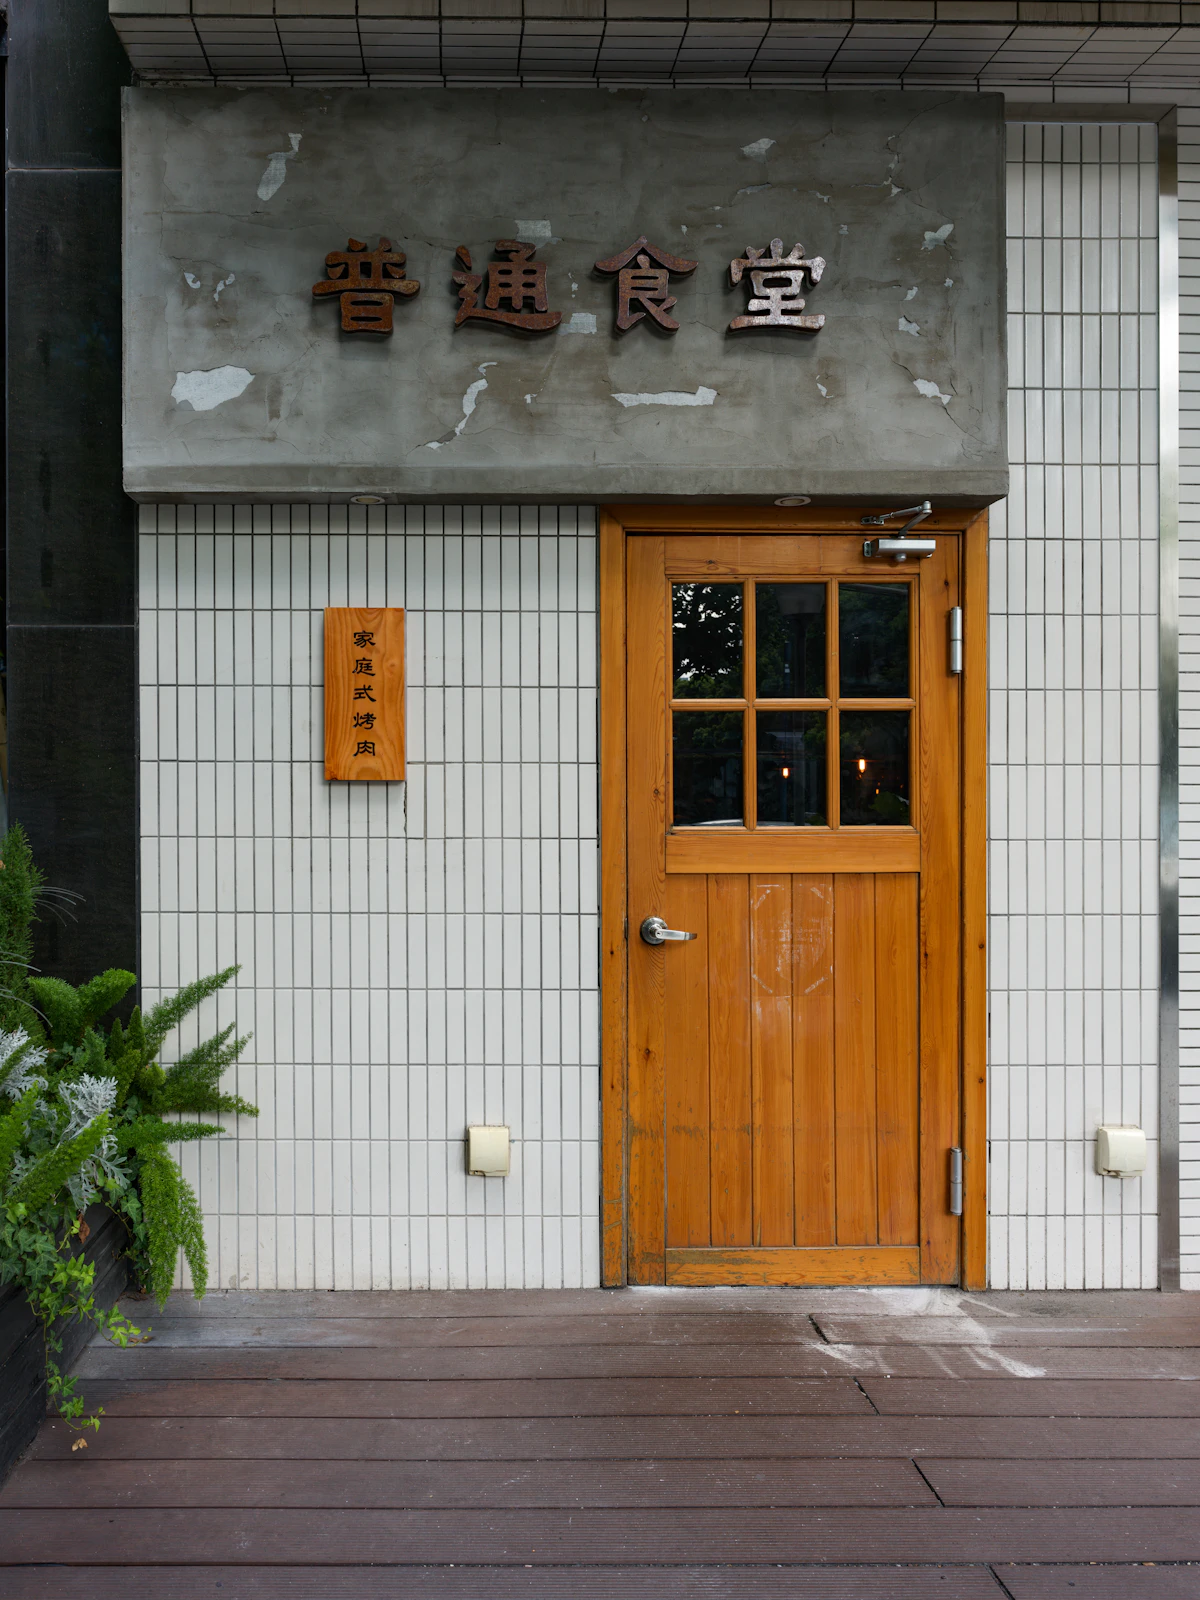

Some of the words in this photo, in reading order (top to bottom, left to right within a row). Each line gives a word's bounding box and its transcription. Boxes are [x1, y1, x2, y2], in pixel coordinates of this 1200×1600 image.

[312, 236, 827, 335] 普通食堂
[352, 630, 377, 757] 家庭式烤肉
